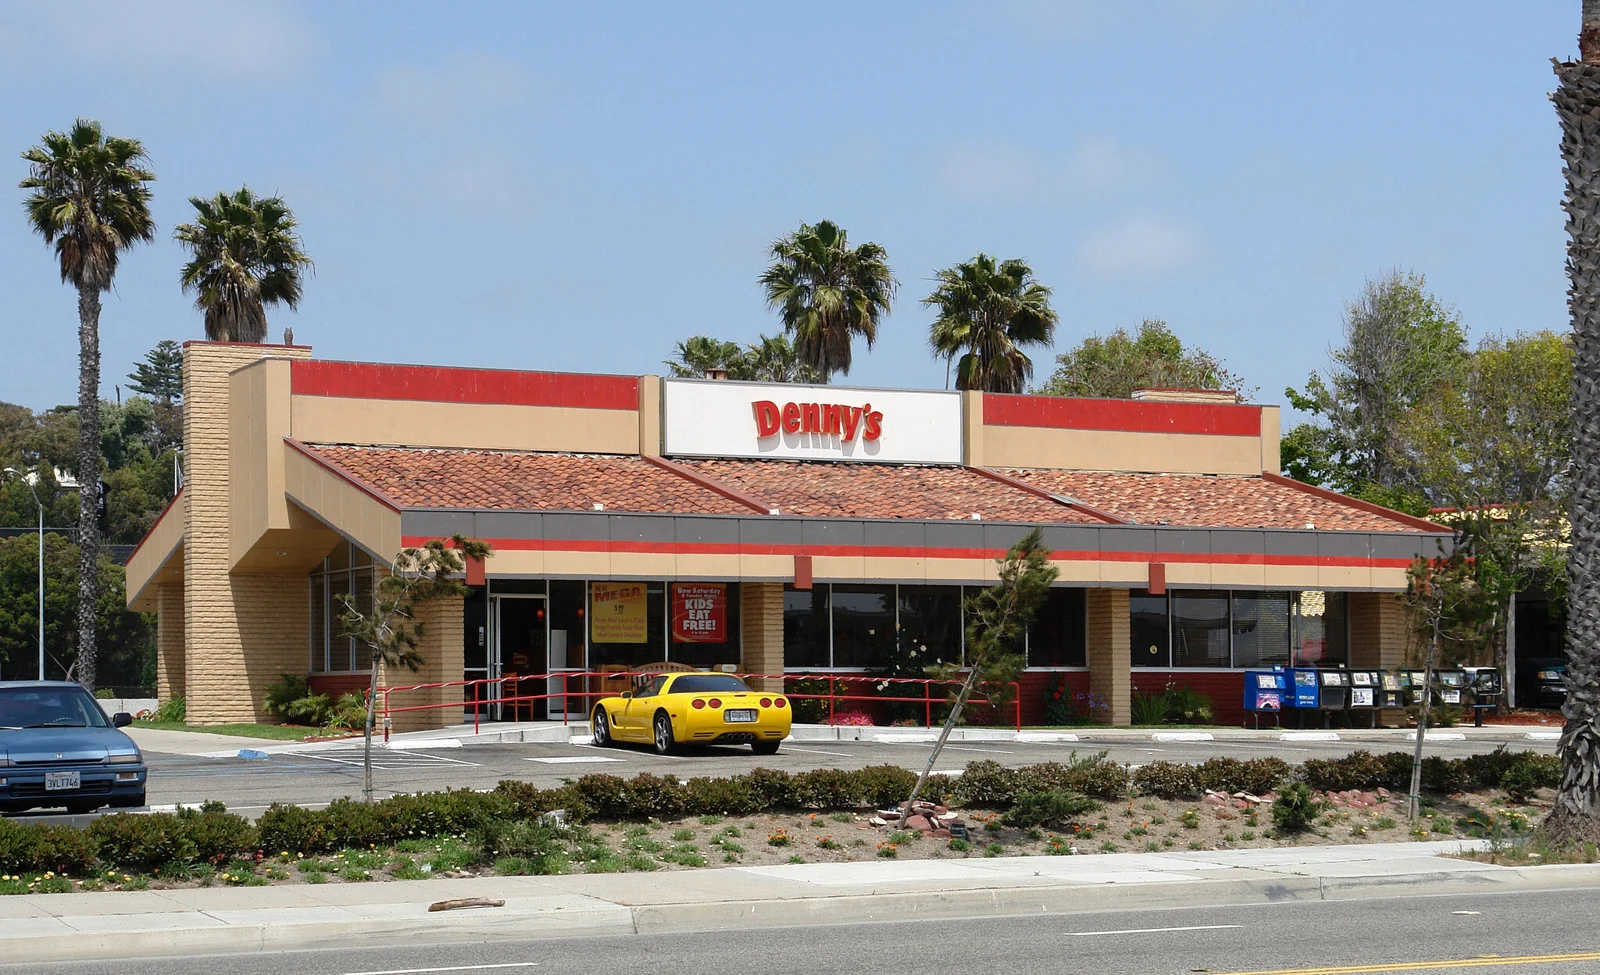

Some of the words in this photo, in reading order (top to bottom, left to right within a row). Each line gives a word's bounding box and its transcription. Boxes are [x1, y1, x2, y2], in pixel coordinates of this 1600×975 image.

[751, 400, 883, 441] Denny's
[595, 587, 642, 602] MEGA
[685, 599, 714, 610] KIDS
[689, 610, 710, 620] EAT
[683, 620, 716, 630] FREE!
[48, 778, 78, 788] 3VLT746
